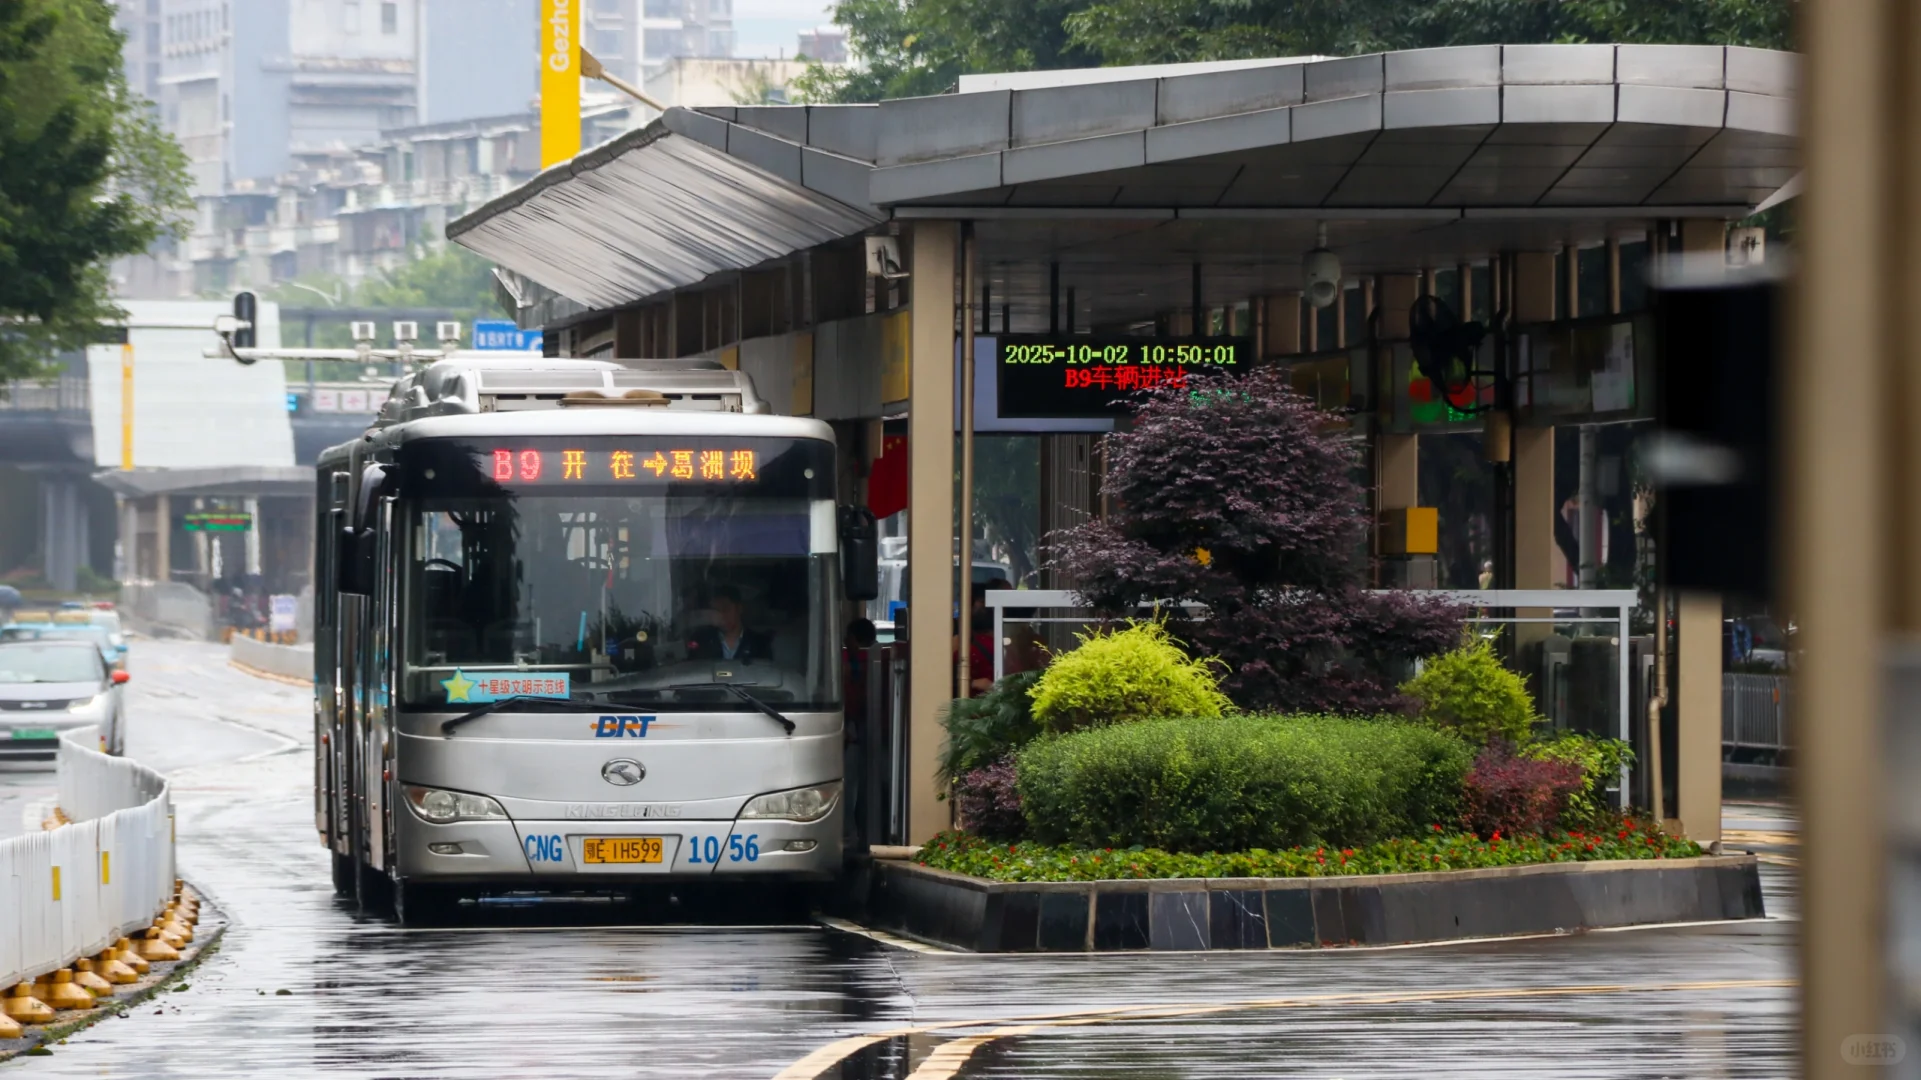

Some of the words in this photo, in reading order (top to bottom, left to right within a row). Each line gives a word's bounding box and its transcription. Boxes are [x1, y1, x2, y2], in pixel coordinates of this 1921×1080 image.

[1005, 345, 1128, 364] 2025-10-02
[1140, 345, 1237, 364] 10:50:01
[1065, 365, 1188, 391] B9车辆进站
[494, 449, 541, 480] B9
[478, 679, 565, 695] 十星级文明示范线
[595, 715, 657, 738] BRT
[525, 834, 563, 862] CNG
